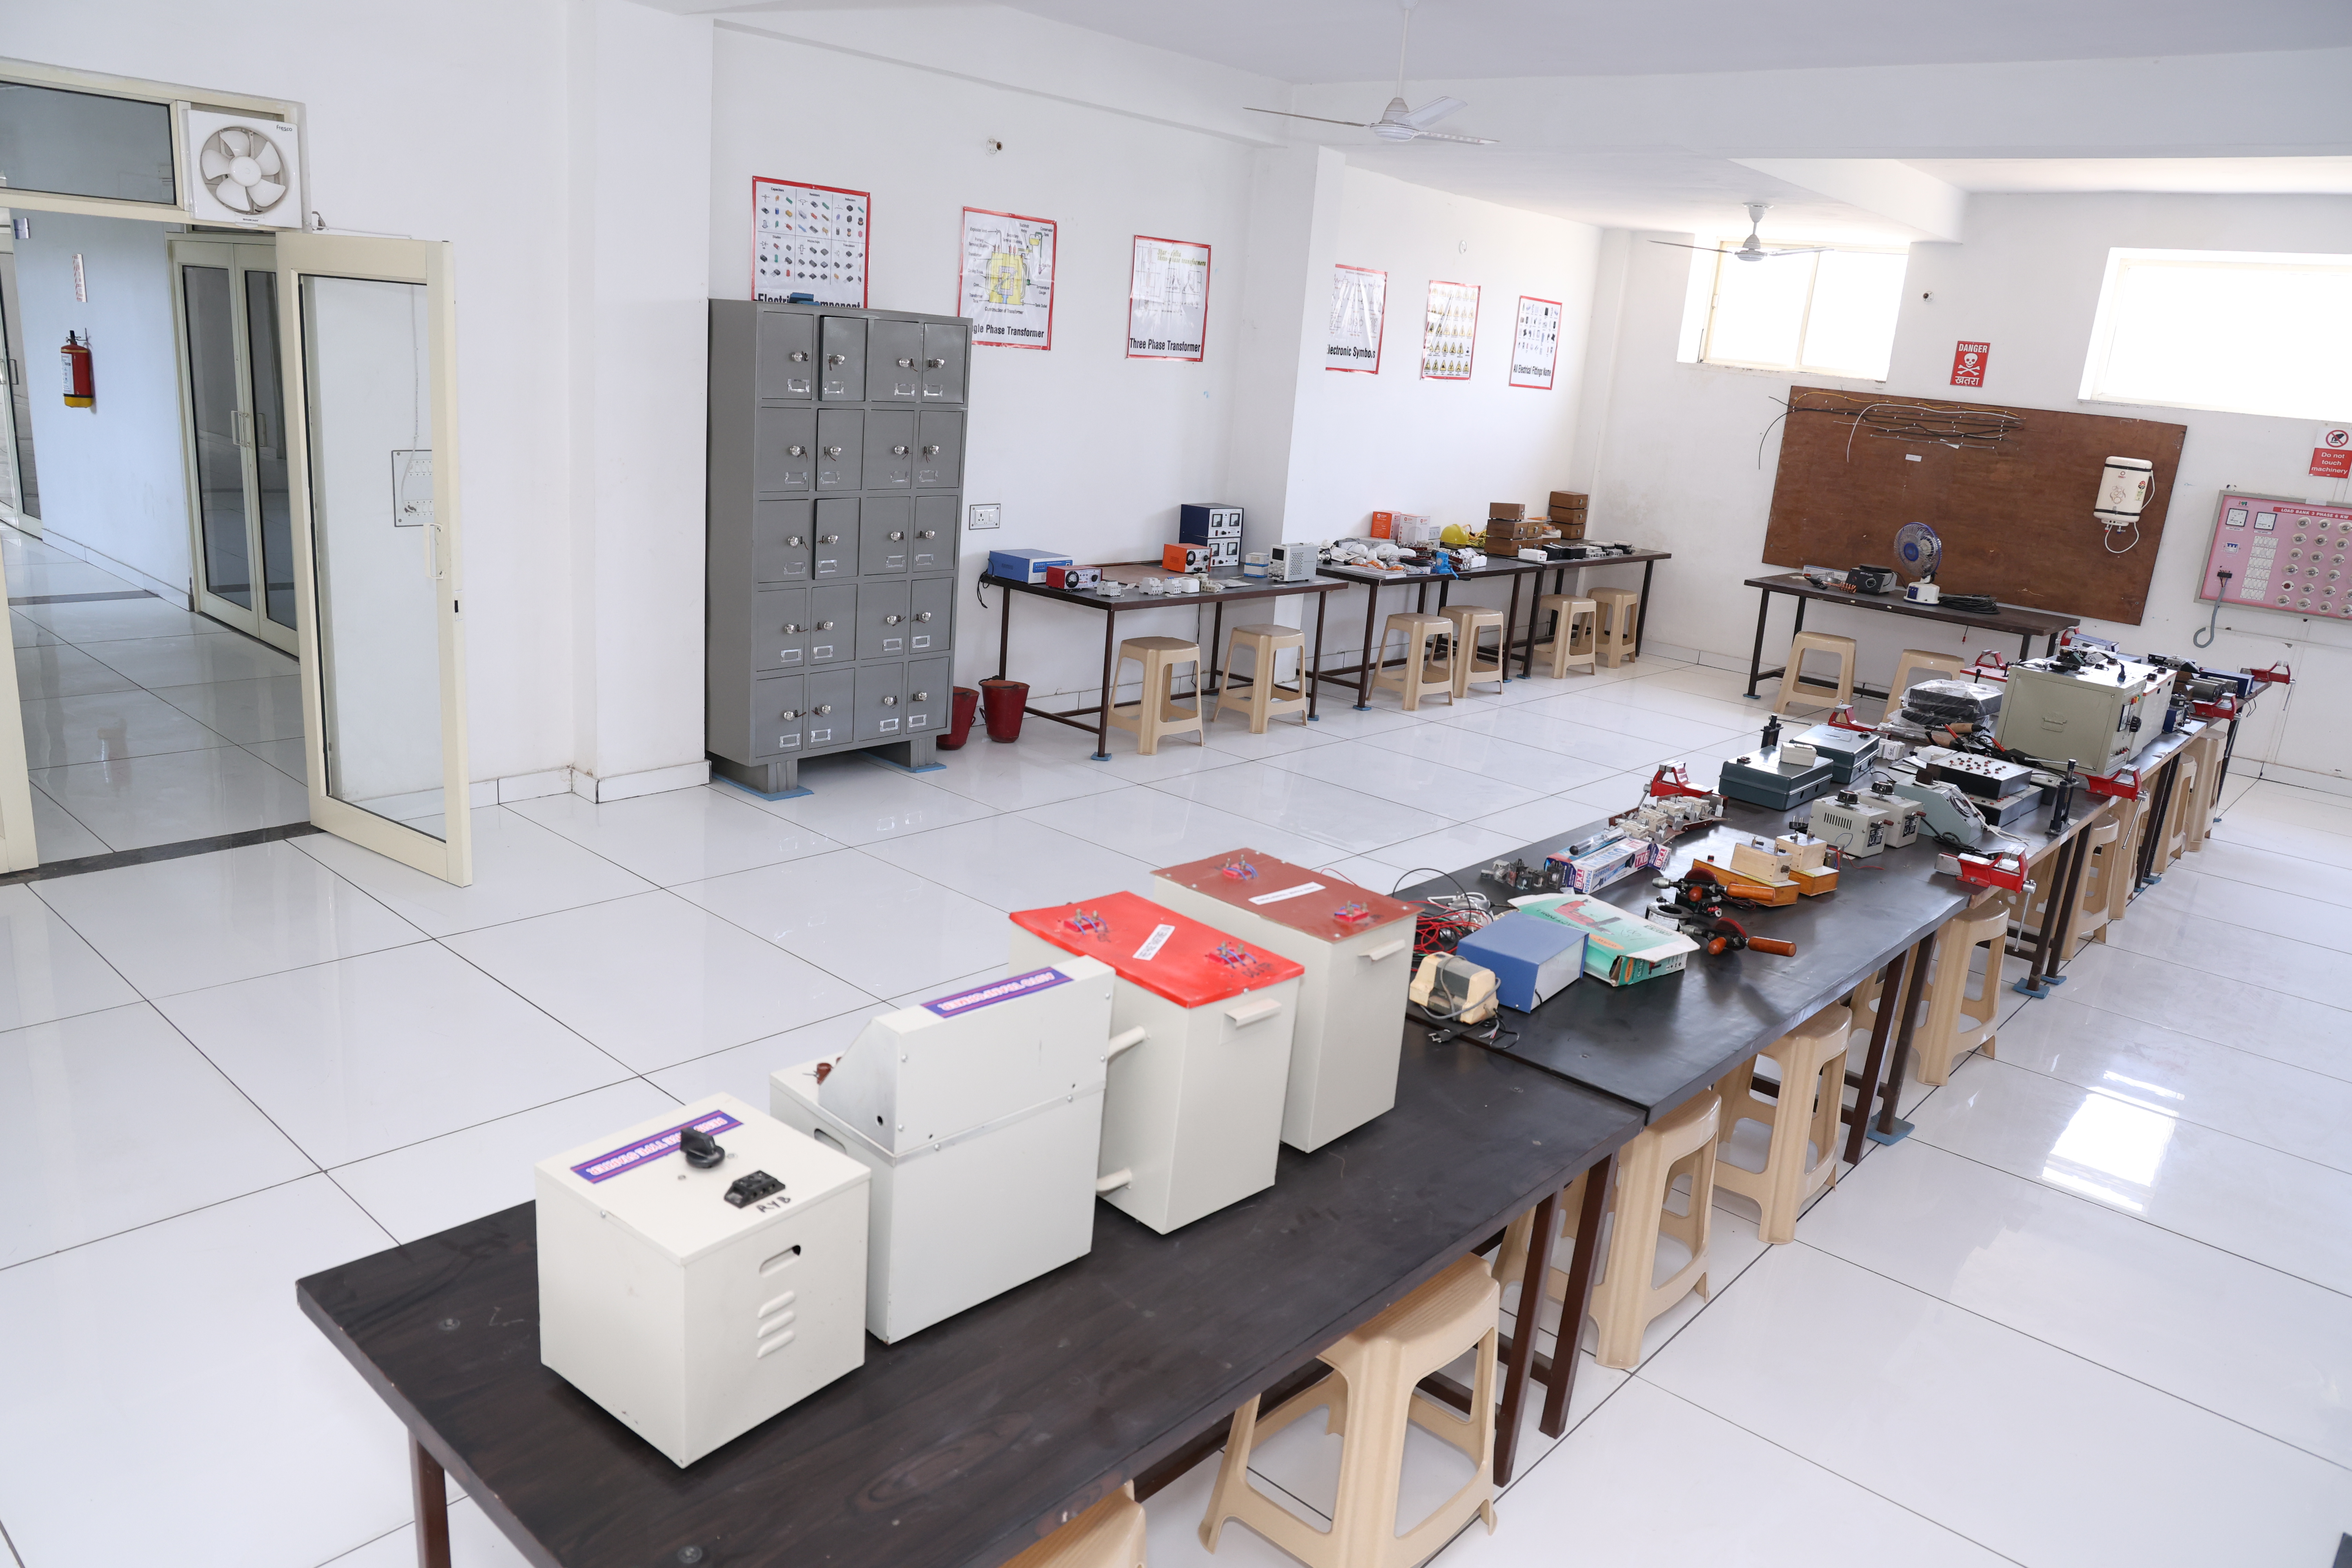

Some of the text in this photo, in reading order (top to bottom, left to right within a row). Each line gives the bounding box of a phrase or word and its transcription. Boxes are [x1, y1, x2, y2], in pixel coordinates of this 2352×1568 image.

[1181, 257, 1207, 267] transformers
[985, 324, 1005, 335] Phase
[1007, 326, 1045, 338] Transformer
[1129, 338, 1201, 352] Three Phase Transformer
[1958, 343, 1988, 353] DANGER
[1353, 346, 1376, 359] Symbols
[1518, 364, 1532, 374] Electrical
[1532, 366, 1543, 377] Fittings
[1543, 367, 1551, 377] Name
[1955, 376, 1980, 385] खतरा
[2311, 466, 2348, 475] machinery
[1580, 848, 1629, 868] THOMSO
[1655, 850, 1667, 865] TXB
[1584, 870, 1592, 893] THOMSON
[1536, 908, 1557, 920] DRILL
[1020, 972, 1055, 989] AUTO
[585, 1117, 728, 1176] RESISNCE TYPE STARTER
